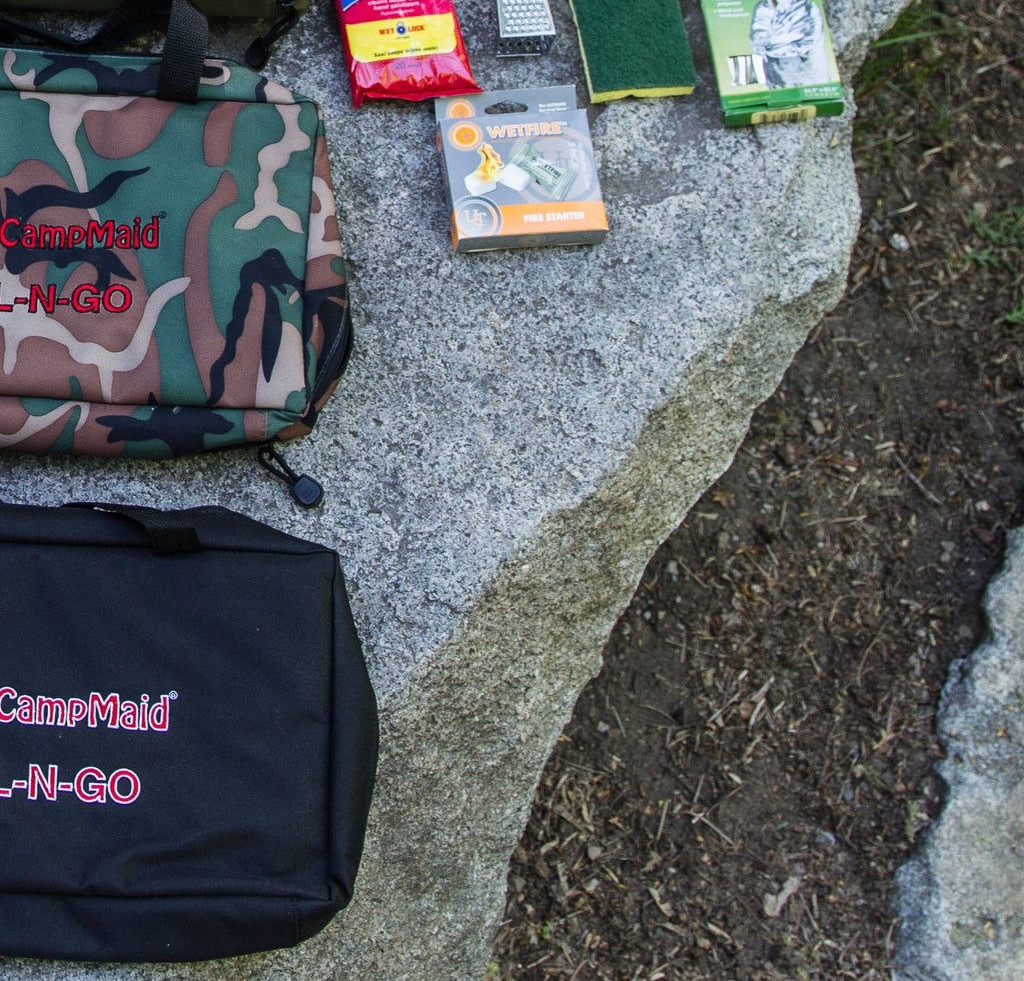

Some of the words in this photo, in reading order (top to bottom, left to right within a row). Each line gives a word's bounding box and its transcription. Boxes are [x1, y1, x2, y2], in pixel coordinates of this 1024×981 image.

[373, 3, 389, 11] hand
[379, 27, 394, 35] WET
[408, 25, 425, 33] LOCK
[486, 121, 563, 139] WETFIRE
[523, 213, 544, 222] FIRE
[545, 211, 585, 222] STARTER
